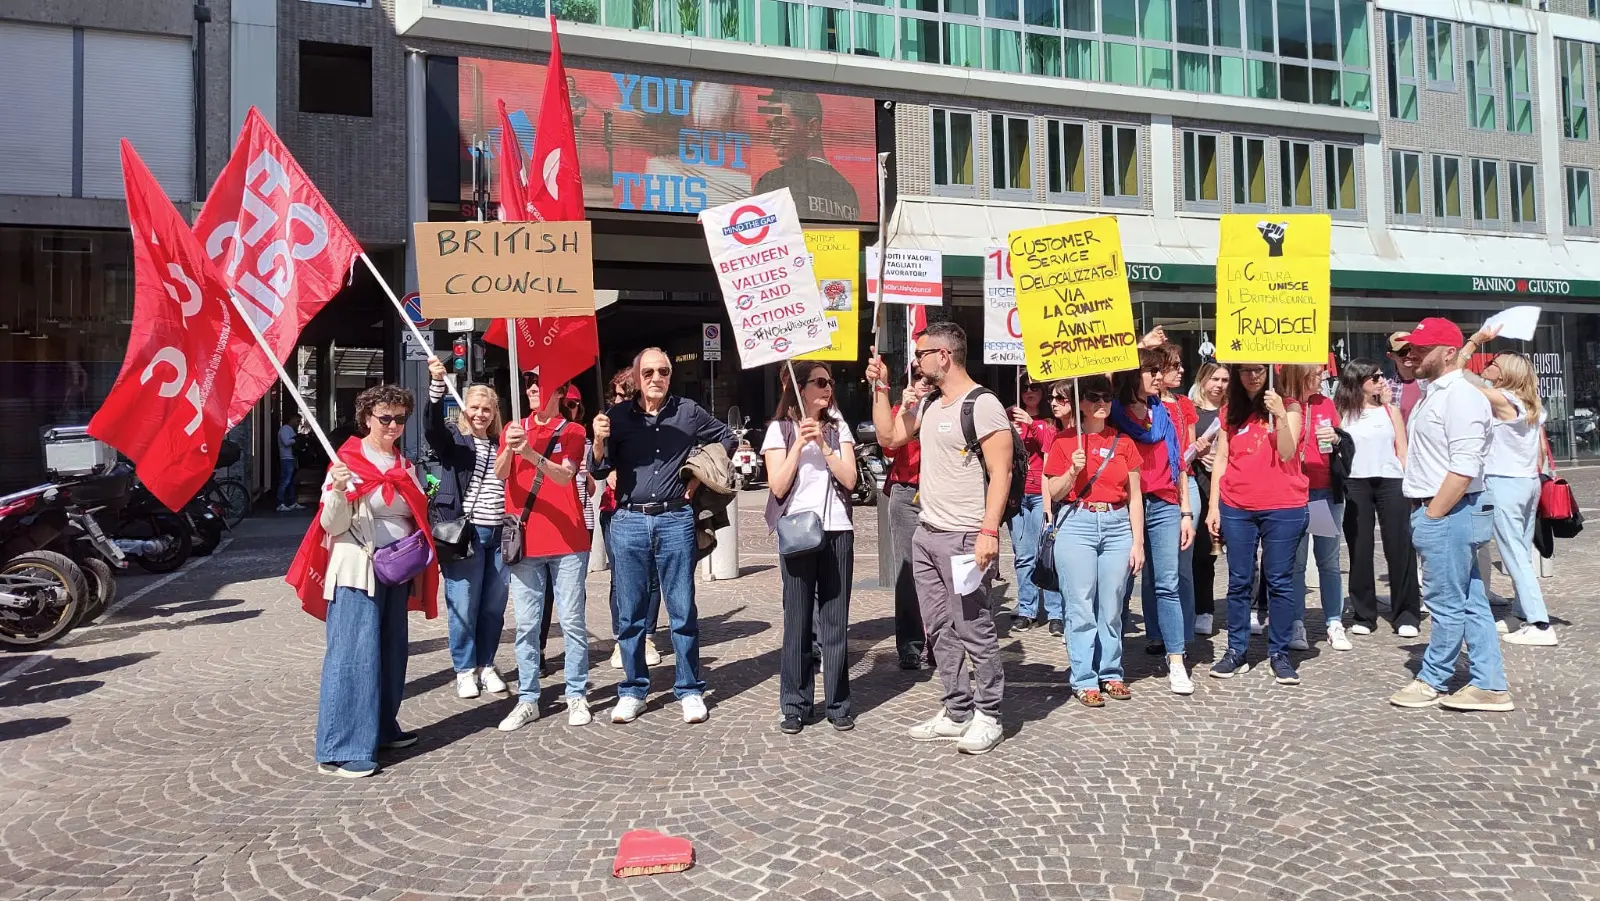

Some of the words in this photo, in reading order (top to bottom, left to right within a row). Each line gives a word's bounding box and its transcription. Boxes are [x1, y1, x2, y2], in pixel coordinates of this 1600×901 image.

[612, 73, 693, 116] YOU
[679, 128, 750, 169] GOT
[613, 172, 706, 213] THIS
[808, 195, 857, 220] BELLINGH
[723, 222, 744, 235] MIND
[743, 218, 759, 230] THE
[760, 214, 776, 226] GAP
[437, 226, 578, 256] BRITISH
[1011, 230, 1100, 256] CUSTOMER
[719, 245, 789, 274] BETWEEN
[1027, 250, 1089, 269] SERVICE
[445, 271, 578, 295] COUNCIL
[732, 267, 788, 291] VALUES
[885, 269, 927, 277] AVORATORI!
[1227, 263, 1242, 281] LA
[760, 283, 791, 301] AND
[1054, 287, 1085, 303] VIA
[1268, 281, 1309, 291] UNISCE
[1472, 277, 1516, 292] PANINO
[1528, 279, 1570, 294] GIUSTO
[742, 302, 806, 330] ACTIONS
[1043, 305, 1063, 319] LA
[1230, 306, 1316, 335] TRADISCE!
[1056, 320, 1106, 338] AVANTI
[1039, 332, 1135, 357] SFRUTTAMENTO
[1533, 353, 1563, 374] GUSTO.
